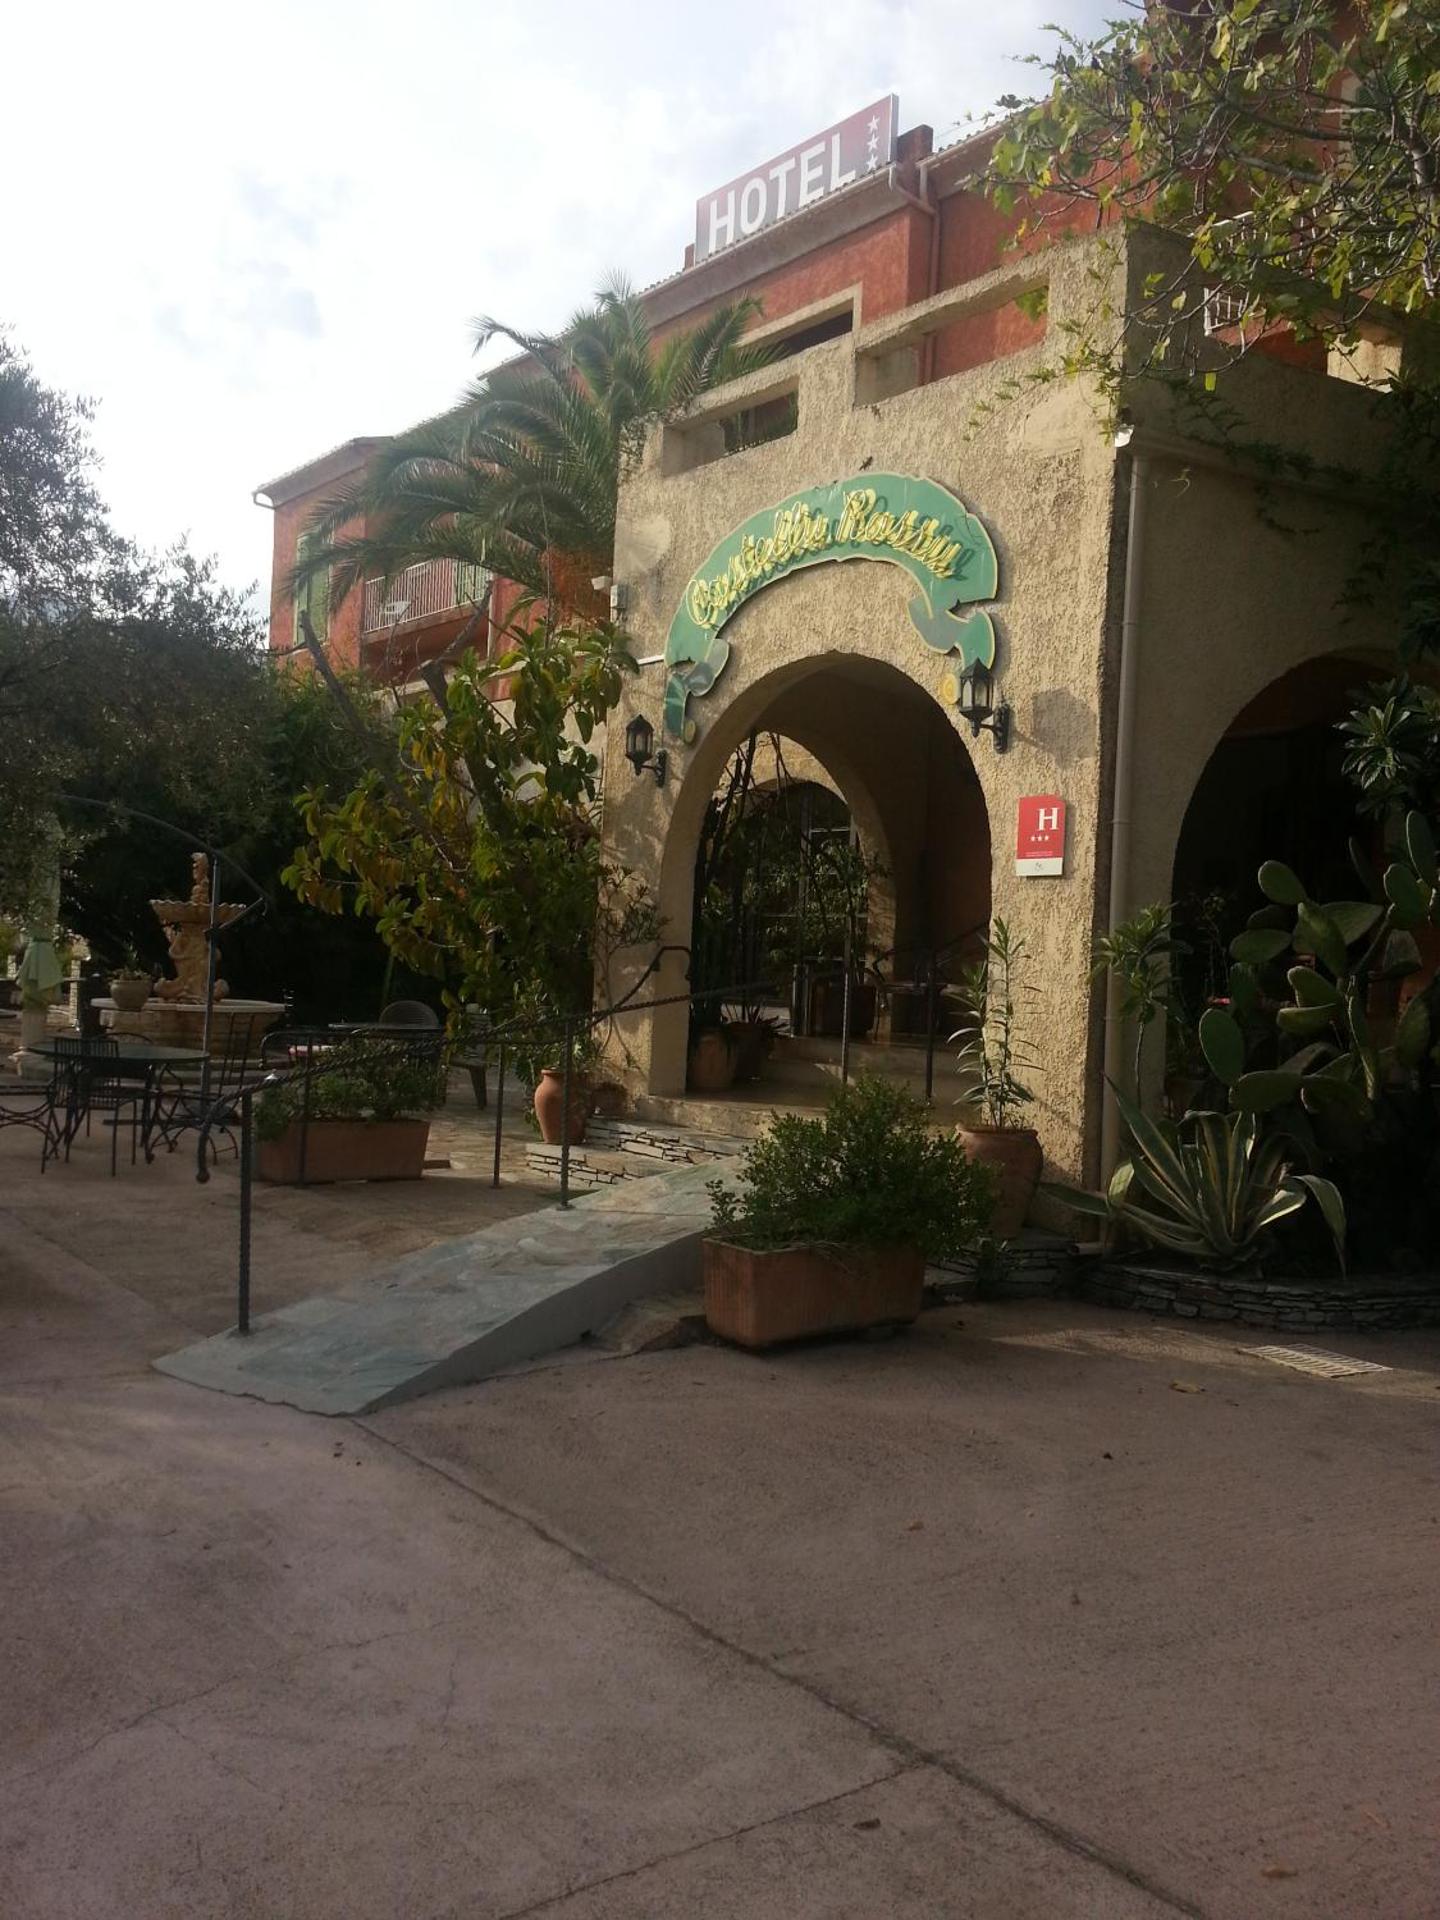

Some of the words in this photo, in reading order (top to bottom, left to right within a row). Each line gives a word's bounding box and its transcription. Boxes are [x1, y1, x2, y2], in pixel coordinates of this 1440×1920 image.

[708, 133, 856, 254] HOTEL
[835, 488, 962, 578] Rossu
[1037, 807, 1060, 831] H
